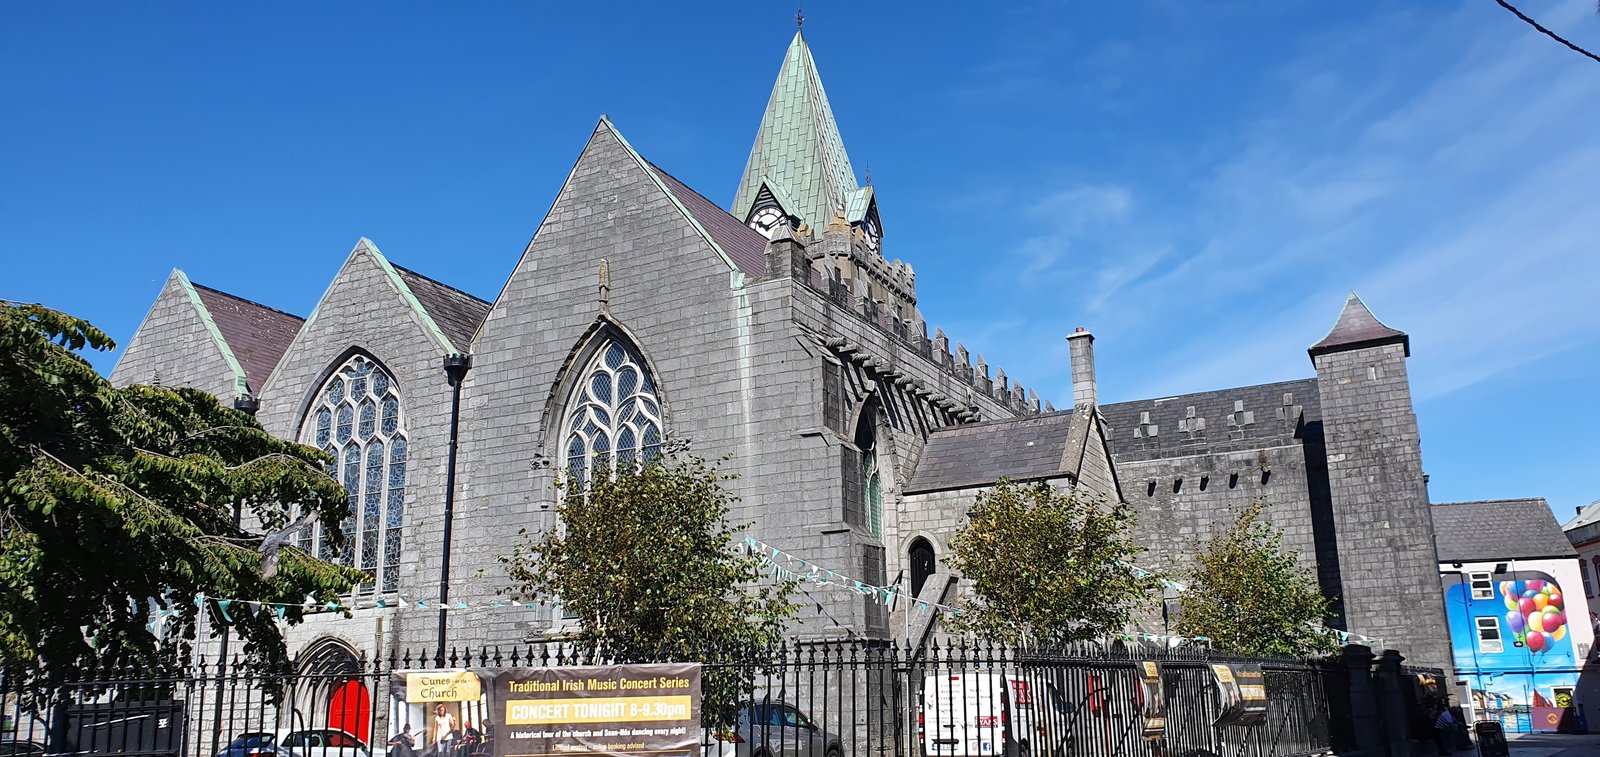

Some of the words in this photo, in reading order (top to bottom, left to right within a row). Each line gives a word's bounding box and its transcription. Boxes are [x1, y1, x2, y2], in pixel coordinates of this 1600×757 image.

[420, 677, 450, 686] Tunes
[508, 680, 560, 692] Traditional
[562, 680, 584, 690] Irish
[588, 678, 617, 690] Music
[620, 677, 658, 690] Concert
[660, 676, 690, 688] Series
[420, 686, 458, 699] Church
[512, 704, 570, 720] CONCERT
[573, 702, 626, 718] TONIGHT
[630, 702, 686, 720] 8-9.30pm
[632, 728, 654, 736] dancing
[670, 727, 687, 736] night!
